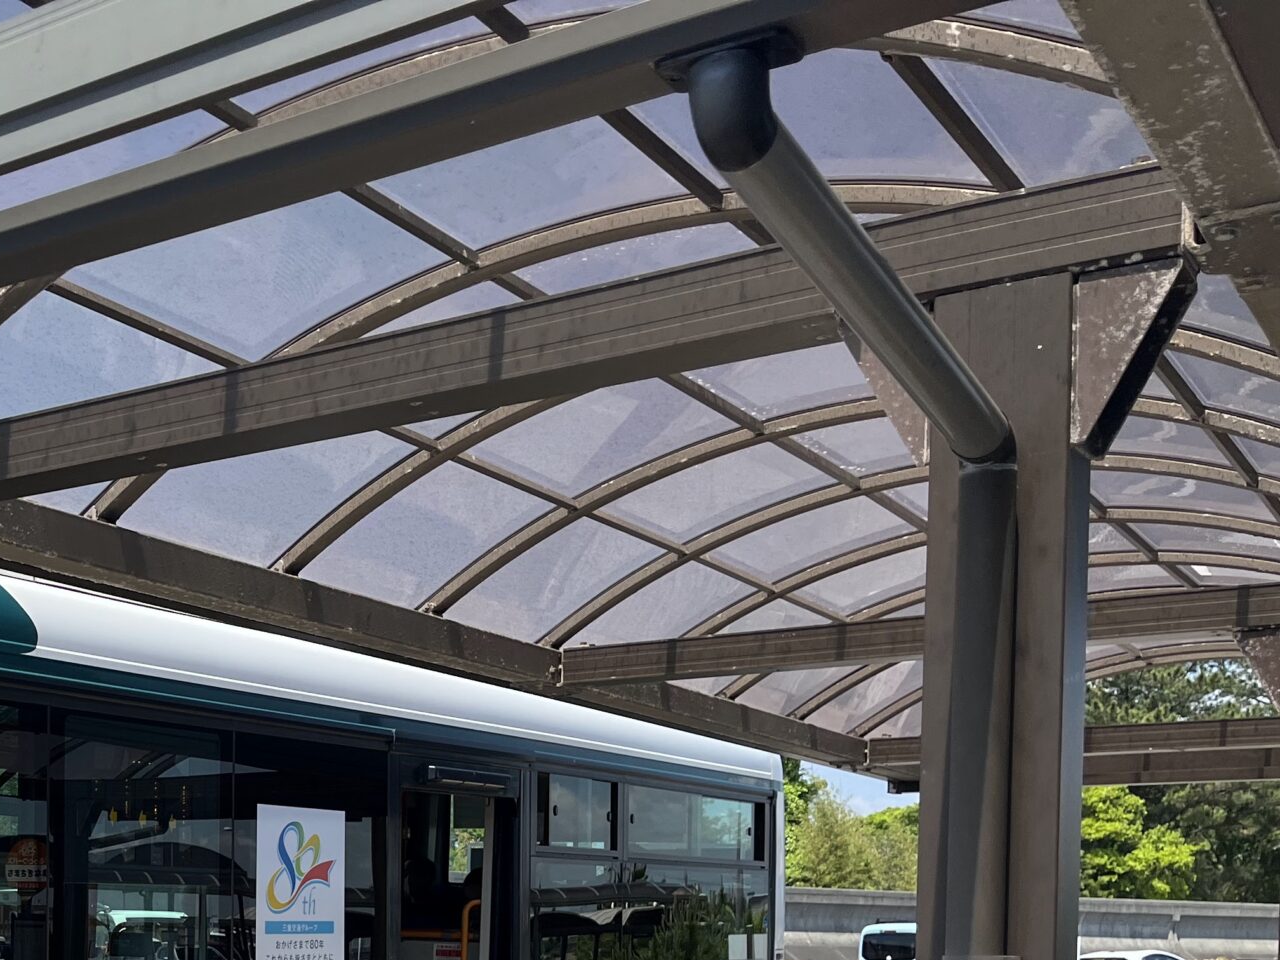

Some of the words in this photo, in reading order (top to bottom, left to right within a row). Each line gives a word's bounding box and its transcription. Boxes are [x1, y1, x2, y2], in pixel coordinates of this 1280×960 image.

[275, 939, 325, 950] おかげさまで80年
